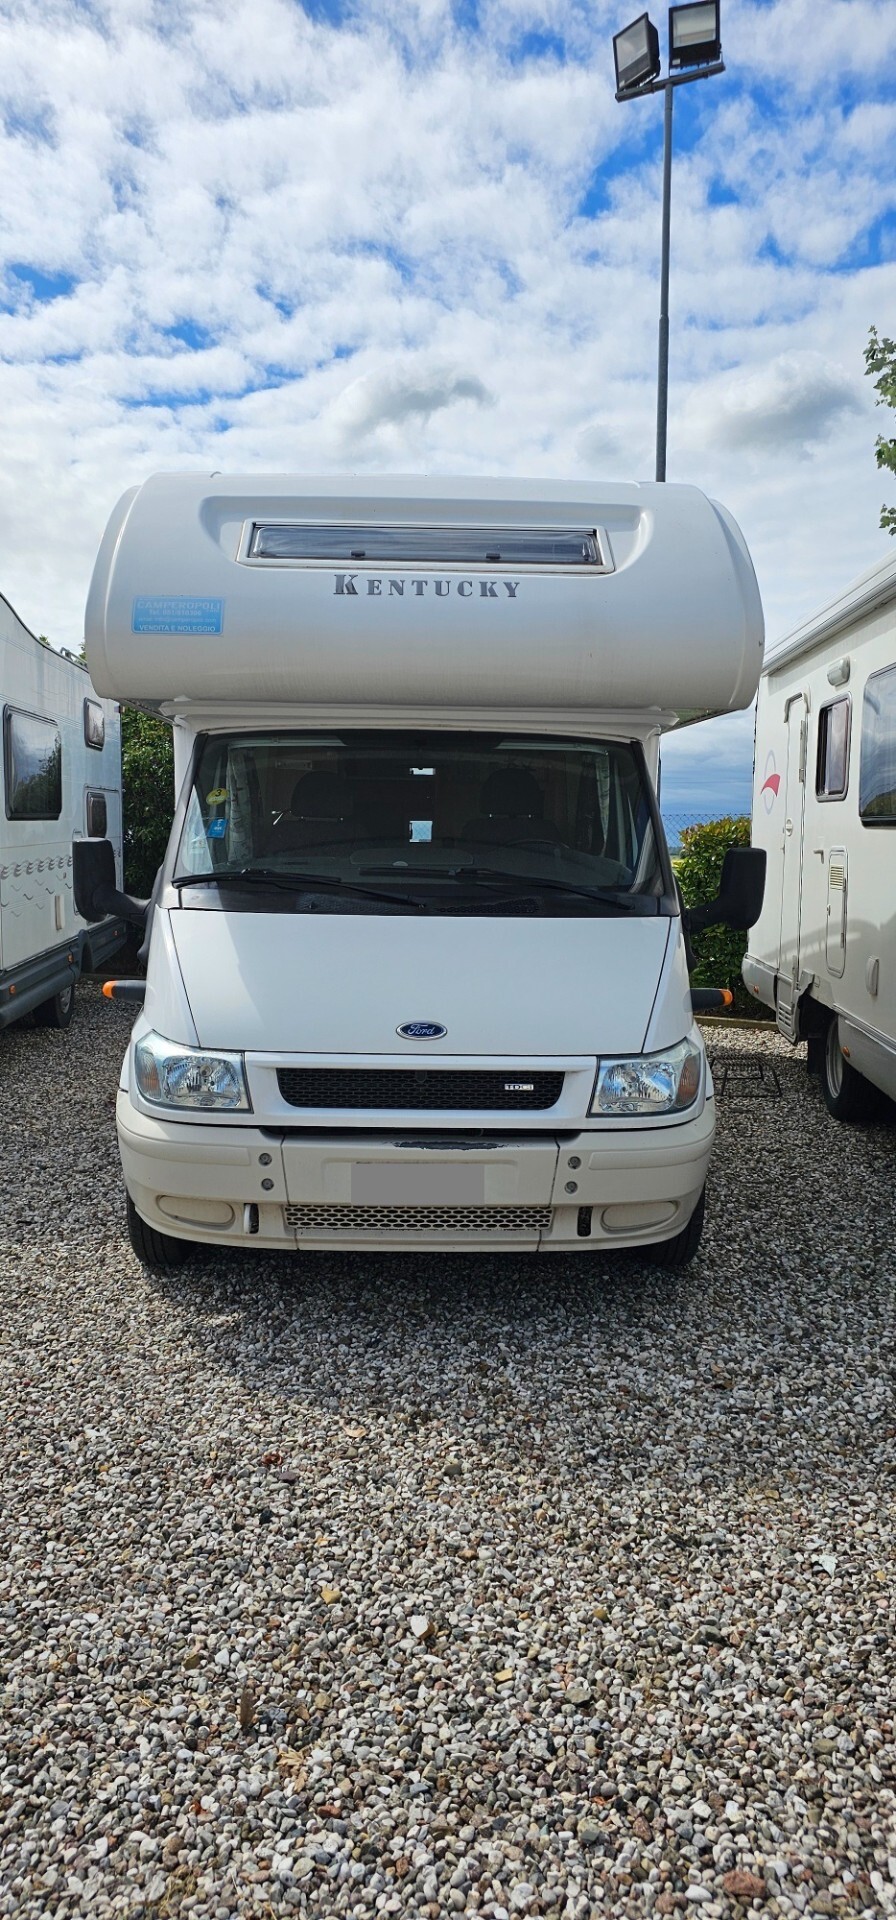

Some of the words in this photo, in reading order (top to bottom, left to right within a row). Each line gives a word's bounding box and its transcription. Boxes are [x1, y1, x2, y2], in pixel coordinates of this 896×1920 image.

[333, 574, 520, 598] KENTUCKY
[137, 601, 220, 610] CAMPEROPOLI
[139, 624, 170, 632] VENDITA
[215, 788, 222, 797] 3
[407, 1023, 436, 1035] Ford
